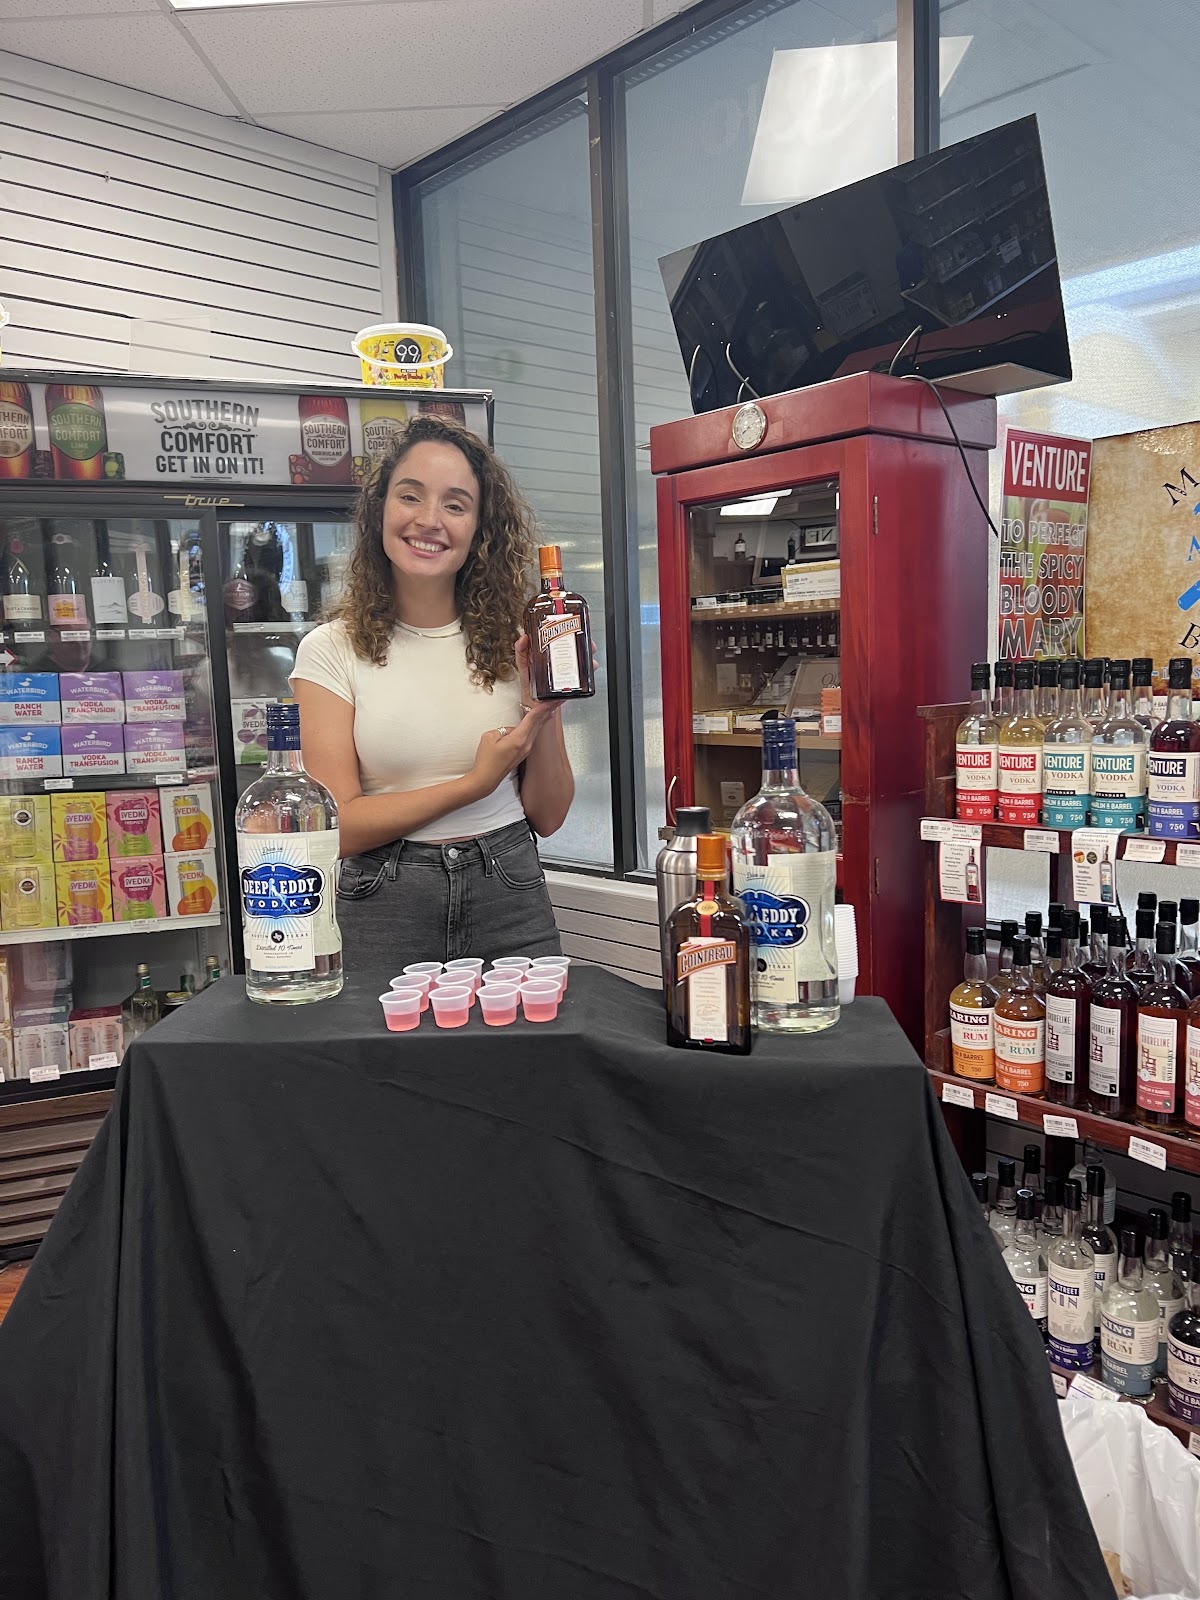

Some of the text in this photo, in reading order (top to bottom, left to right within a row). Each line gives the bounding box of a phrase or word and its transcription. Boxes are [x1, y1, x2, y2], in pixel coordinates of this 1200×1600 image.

[151, 400, 259, 427] SOUTHERN
[51, 413, 102, 427] SOUTHERN
[55, 429, 100, 441] COMFORT
[304, 424, 347, 436] SOUTHERN
[160, 431, 256, 454] COMFORT
[307, 438, 346, 449] COMFORT
[155, 455, 264, 474] GET IN ON IT!
[1010, 440, 1087, 493] VENTURE
[1002, 518, 1086, 547] TO PERFECT
[1001, 552, 1084, 579] THE SPICY
[1000, 584, 1083, 615] BLOODY
[542, 618, 579, 643] COINTREAU
[1000, 618, 1083, 660] MARY
[6, 687, 47, 695] WATERBIRD
[70, 686, 109, 694] WATERBIRD
[134, 685, 172, 693] WATERBIRD
[132, 704, 180, 712] TRANSFUSION
[7, 742, 48, 750] WATERBIRD
[73, 740, 112, 748] WATERBIRD
[134, 737, 172, 745] WATERBIRD
[132, 756, 180, 764] TRANSFUSION
[1093, 757, 1132, 770] VENTURE
[121, 811, 145, 819] SVEDKA
[174, 807, 200, 815] SVEDKA
[66, 815, 92, 823] SVEDKA
[179, 872, 204, 880] SVEDKA
[71, 882, 97, 890] SVEDKA
[125, 878, 150, 886] SVEDKA
[243, 878, 315, 895] DEEP EDDY
[248, 898, 311, 908] VODKA
[761, 908, 799, 923] EDDY
[681, 946, 732, 973] COINTREAU
[963, 1032, 988, 1041] RUM
[1010, 1046, 1036, 1055] RUM
[1009, 1067, 1031, 1075] BARREL
[1057, 1285, 1078, 1295] STREET
[1050, 1290, 1078, 1309] GIN
[1107, 1338, 1132, 1354] RUM
[1106, 1360, 1128, 1375] BARREL
